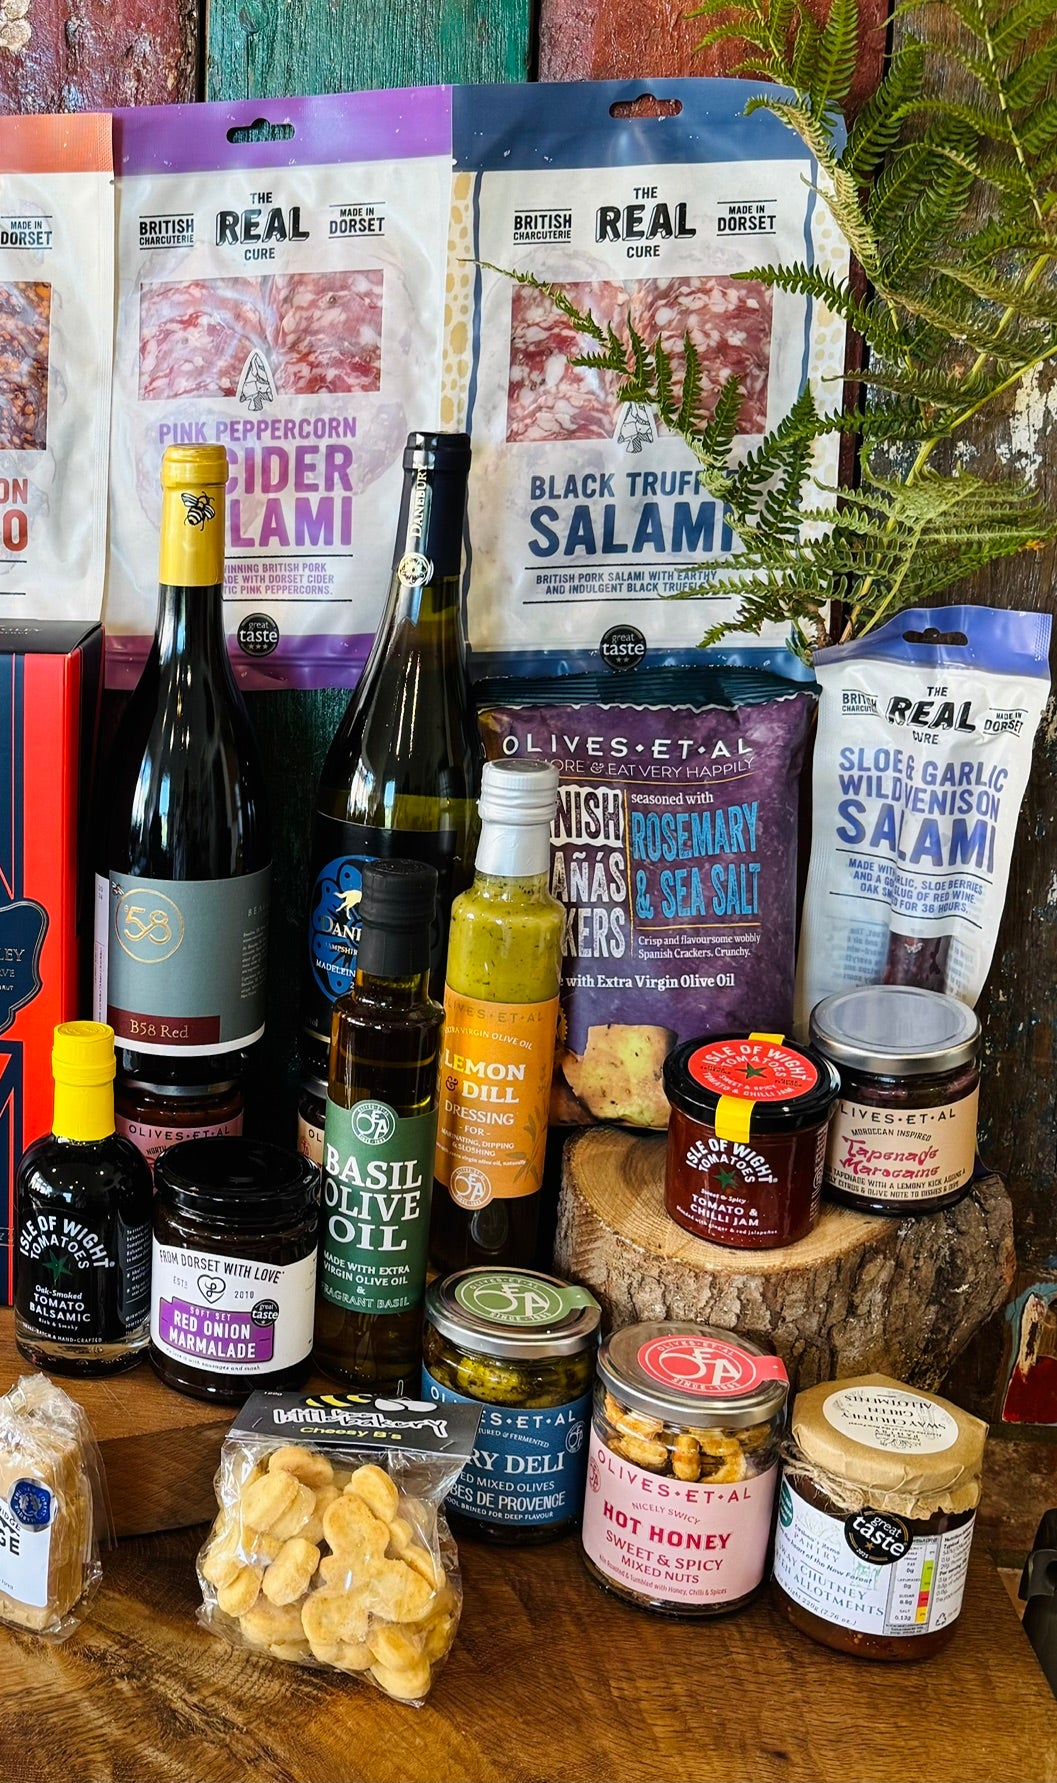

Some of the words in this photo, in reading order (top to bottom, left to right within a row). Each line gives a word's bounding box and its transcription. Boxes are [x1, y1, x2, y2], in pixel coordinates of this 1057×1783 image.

[250, 192, 272, 204] THE
[634, 187, 658, 199] THE
[340, 208, 363, 218] MADE
[728, 206, 753, 214] MADE
[756, 205, 765, 213] IN
[10, 221, 32, 230] MADE
[216, 207, 310, 246] REAL
[330, 217, 385, 234] DORSET
[514, 214, 572, 230] BRITISH
[596, 202, 696, 242] REAL
[718, 215, 776, 231] DORSET
[0, 230, 52, 246] DORSET
[139, 234, 194, 246] CHARCUTERIE
[514, 230, 571, 240] CHARCUTERIE
[244, 248, 275, 261] CURE
[626, 246, 660, 258] CURE
[160, 422, 207, 444] PINK
[216, 417, 356, 441] PEPPERCORN
[226, 445, 353, 496] CIDER
[531, 473, 615, 500] BLACK
[529, 501, 734, 557] SALAMI
[262, 563, 299, 573] BRITISH
[302, 562, 326, 572] PORK
[536, 574, 574, 584] BRITISH
[578, 573, 604, 583] PORK
[608, 572, 644, 582] SALAMI
[649, 571, 674, 581] WITH
[242, 574, 265, 584] WITH
[307, 574, 334, 584] CIDER
[546, 585, 565, 594] AND
[569, 584, 624, 593] INDULGENT
[627, 583, 658, 592] BLACK
[240, 628, 278, 642] taste
[927, 687, 947, 697] THE
[886, 696, 975, 732] REAL
[608, 763, 635, 776] EAT
[639, 765, 682, 778] VERY
[686, 758, 754, 778] HAPPILY
[839, 747, 903, 773] SLOE
[922, 760, 1008, 792] GARLIC
[631, 793, 683, 805] seasoned
[686, 792, 713, 804] with
[839, 774, 902, 801] WILD
[903, 783, 1000, 823] VENISON
[631, 801, 758, 862] ROSEMARY
[836, 798, 995, 874] SALAMI
[660, 867, 706, 919] SEA
[712, 863, 760, 916] SALT
[948, 879, 983, 894] BERRIES
[639, 936, 662, 948] Crisp
[734, 932, 761, 946] wobbly
[568, 974, 594, 986] with
[597, 975, 632, 987] Extra
[634, 974, 678, 991] Virgin
[680, 974, 714, 987] Olive
[716, 974, 734, 986] Oil
[130, 1020, 156, 1037] B58
[160, 1025, 188, 1039] Red
[445, 1048, 526, 1081] LEMON
[702, 1047, 736, 1065] ISLE
[740, 1045, 762, 1054] OF
[462, 1080, 519, 1103] DILL
[445, 1100, 515, 1125] DRESSING
[851, 1128, 894, 1136] MOROCCAN
[897, 1130, 932, 1142] INSPIRED
[686, 1140, 708, 1168] ISLE
[708, 1138, 728, 1152] OF
[842, 1136, 939, 1166] Tapenade
[326, 1143, 422, 1192] BASIL
[325, 1179, 420, 1222] OLIVE
[692, 1194, 744, 1215] TOMATO
[690, 1204, 729, 1223] CHILLI
[733, 1218, 759, 1226] JAM
[329, 1215, 407, 1252] OIL
[30, 1235, 90, 1269] TOMATOES
[159, 1250, 179, 1270] FROM
[181, 1254, 219, 1274] DORSET
[224, 1264, 251, 1279] WITH
[379, 1264, 410, 1274] EXTRA
[356, 1274, 390, 1287] OLIVE
[393, 1276, 408, 1286] OIL
[34, 1293, 85, 1311] TOMATO
[35, 1285, 82, 1300] Oak-Smoked
[29, 1302, 91, 1322] BALSAMIC
[174, 1310, 197, 1331] RED
[204, 1321, 251, 1340] ONION
[169, 1326, 256, 1359] MARMALADE
[504, 1451, 565, 1475] DELI
[477, 1477, 515, 1491] MIXED
[517, 1481, 555, 1492] OLIVES
[477, 1491, 494, 1508] DE
[499, 1491, 566, 1511] PROVENCE
[603, 1500, 642, 1535] HOT
[649, 1525, 733, 1550] HONEY
[853, 1515, 905, 1557] taste
[606, 1529, 654, 1562] SWEET
[675, 1558, 724, 1571] SPICY
[621, 1555, 662, 1578] MIXED
[664, 1571, 700, 1584] NUTS
[794, 1575, 884, 1617] ALLOTMENTS
